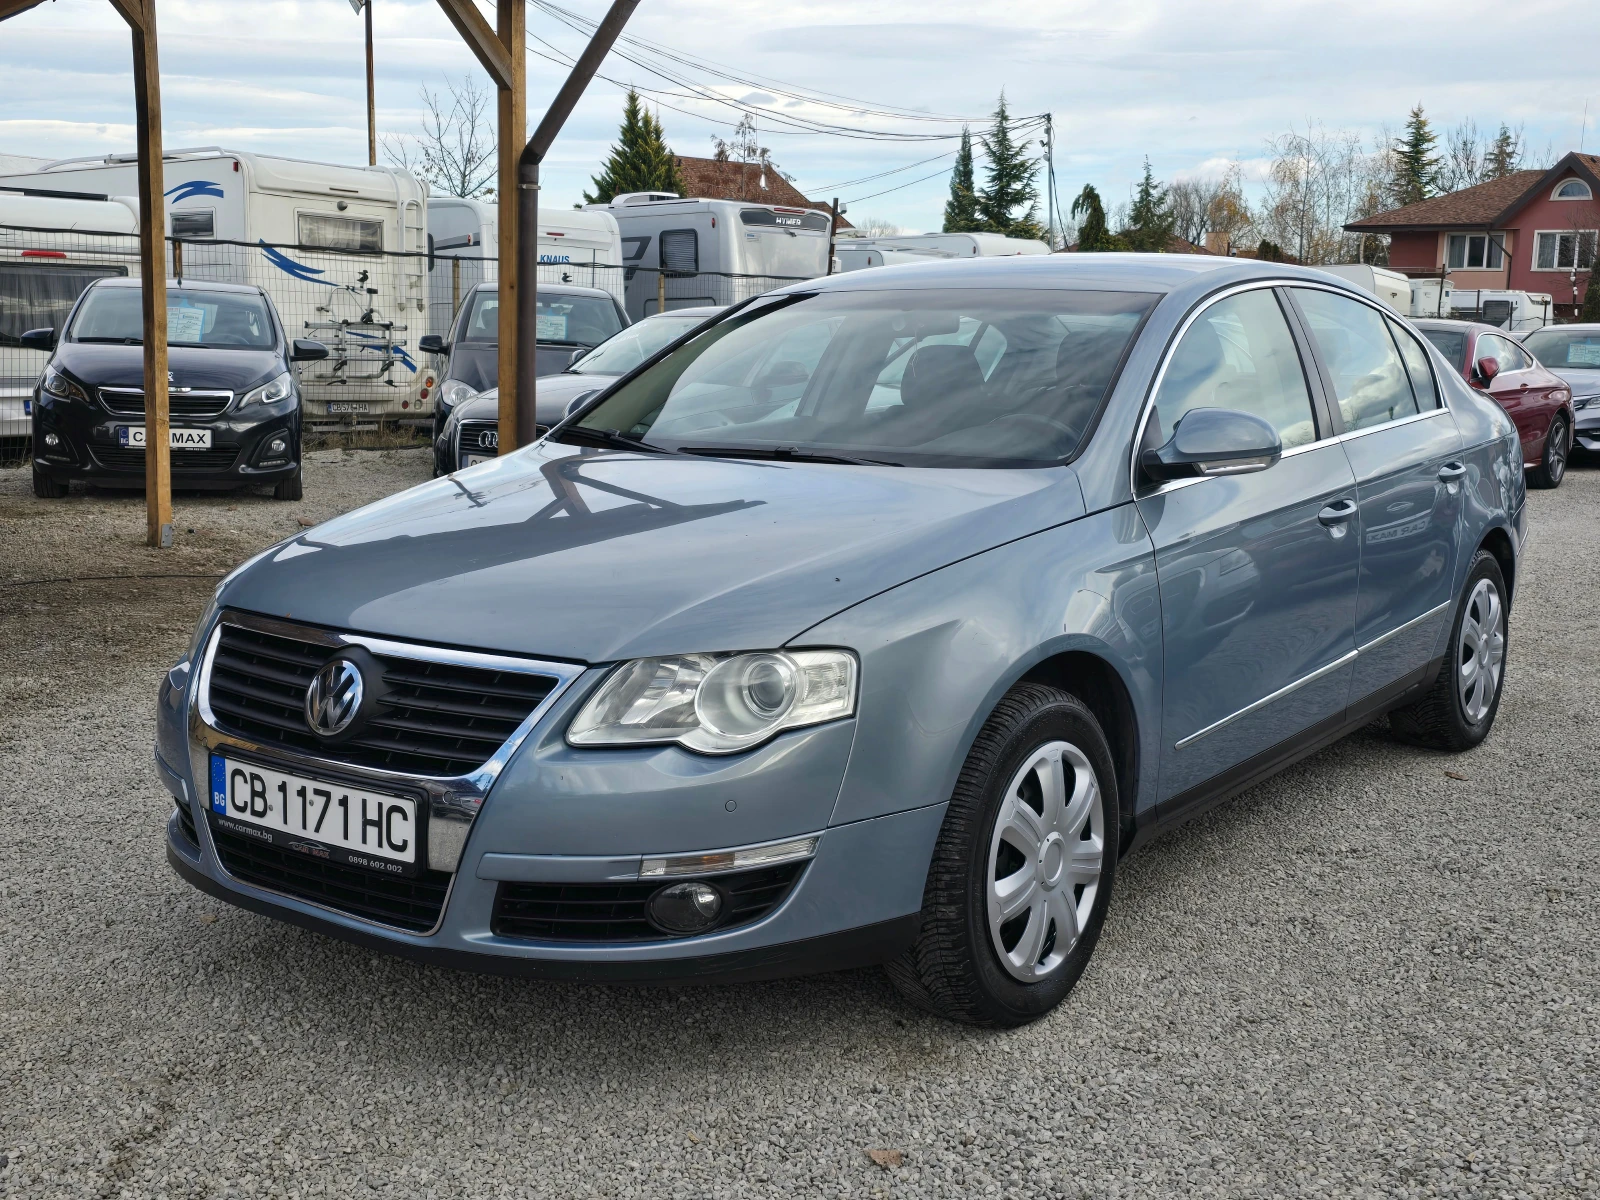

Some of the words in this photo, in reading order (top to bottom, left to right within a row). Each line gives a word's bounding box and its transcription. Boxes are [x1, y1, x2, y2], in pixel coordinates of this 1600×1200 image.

[776, 217, 801, 225] HYMER
[540, 254, 570, 263] KNAUS
[172, 433, 206, 444] MAX
[214, 791, 225, 806] BG
[230, 768, 268, 818] CB
[277, 780, 349, 841] 1171
[361, 797, 409, 853] HC
[217, 818, 273, 843] www.carmax.bg
[348, 855, 368, 866] 0898
[369, 860, 385, 870] 602
[386, 863, 403, 873] 002
